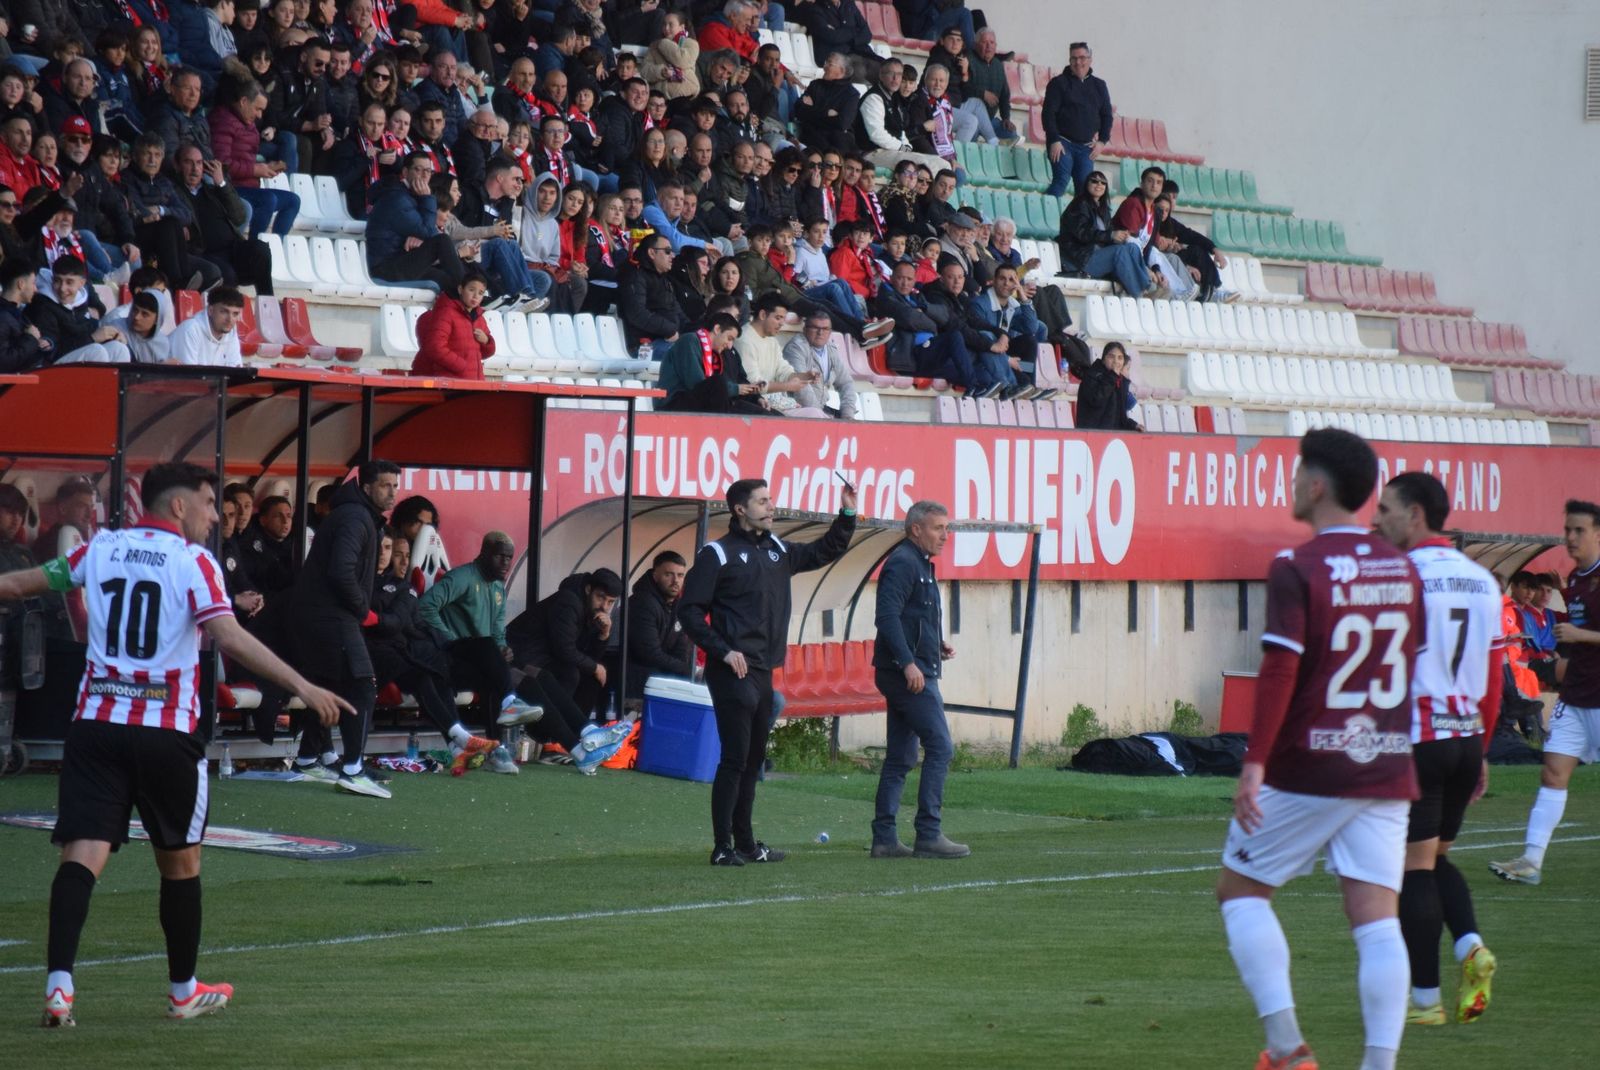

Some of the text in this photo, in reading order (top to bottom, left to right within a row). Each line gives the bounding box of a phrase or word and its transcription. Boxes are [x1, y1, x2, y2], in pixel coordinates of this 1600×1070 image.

[584, 416, 741, 498] RÓTULOS
[1167, 451, 1302, 508] FABRICA
[763, 434, 1136, 568] Gráficas DUERO
[124, 549, 167, 567] RAMOS
[99, 577, 162, 659] 10
[1449, 608, 1469, 686] 7
[1325, 611, 1411, 709] 23
